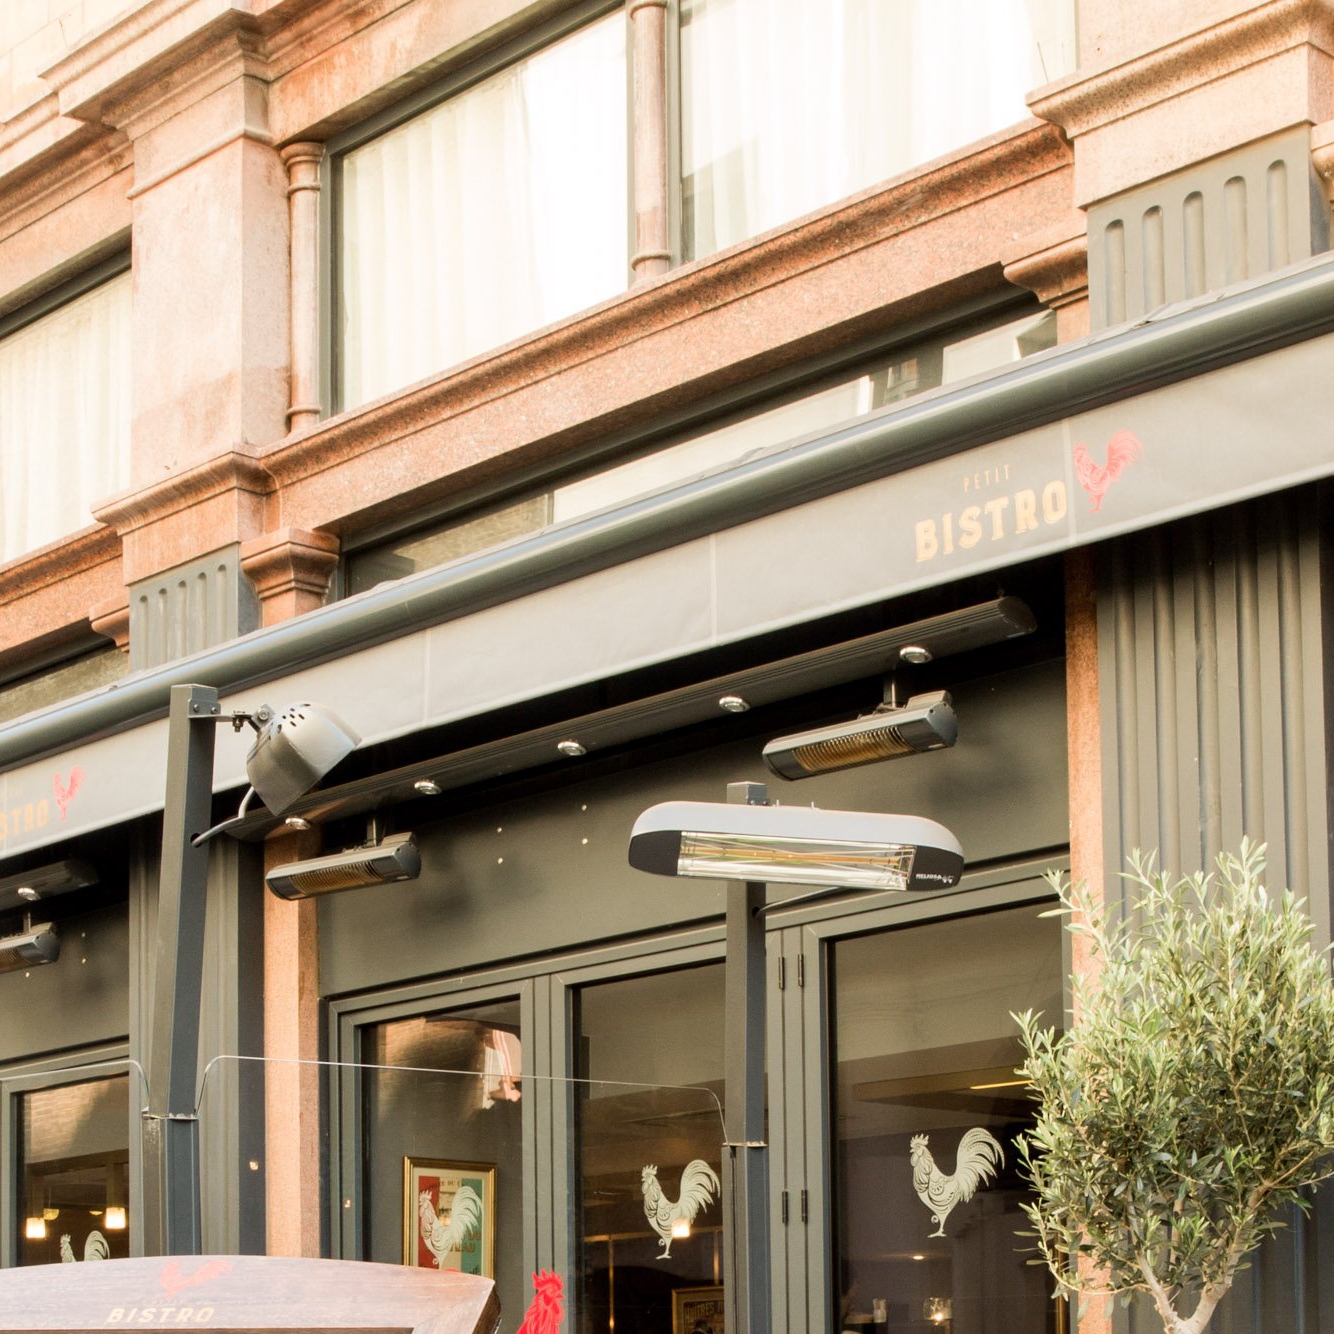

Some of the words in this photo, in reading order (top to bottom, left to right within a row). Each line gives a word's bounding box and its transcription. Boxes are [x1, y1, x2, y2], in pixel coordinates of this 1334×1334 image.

[963, 464, 1011, 493] PETIT
[915, 479, 1067, 562] BISTRO
[105, 1307, 215, 1324] BISTRO
